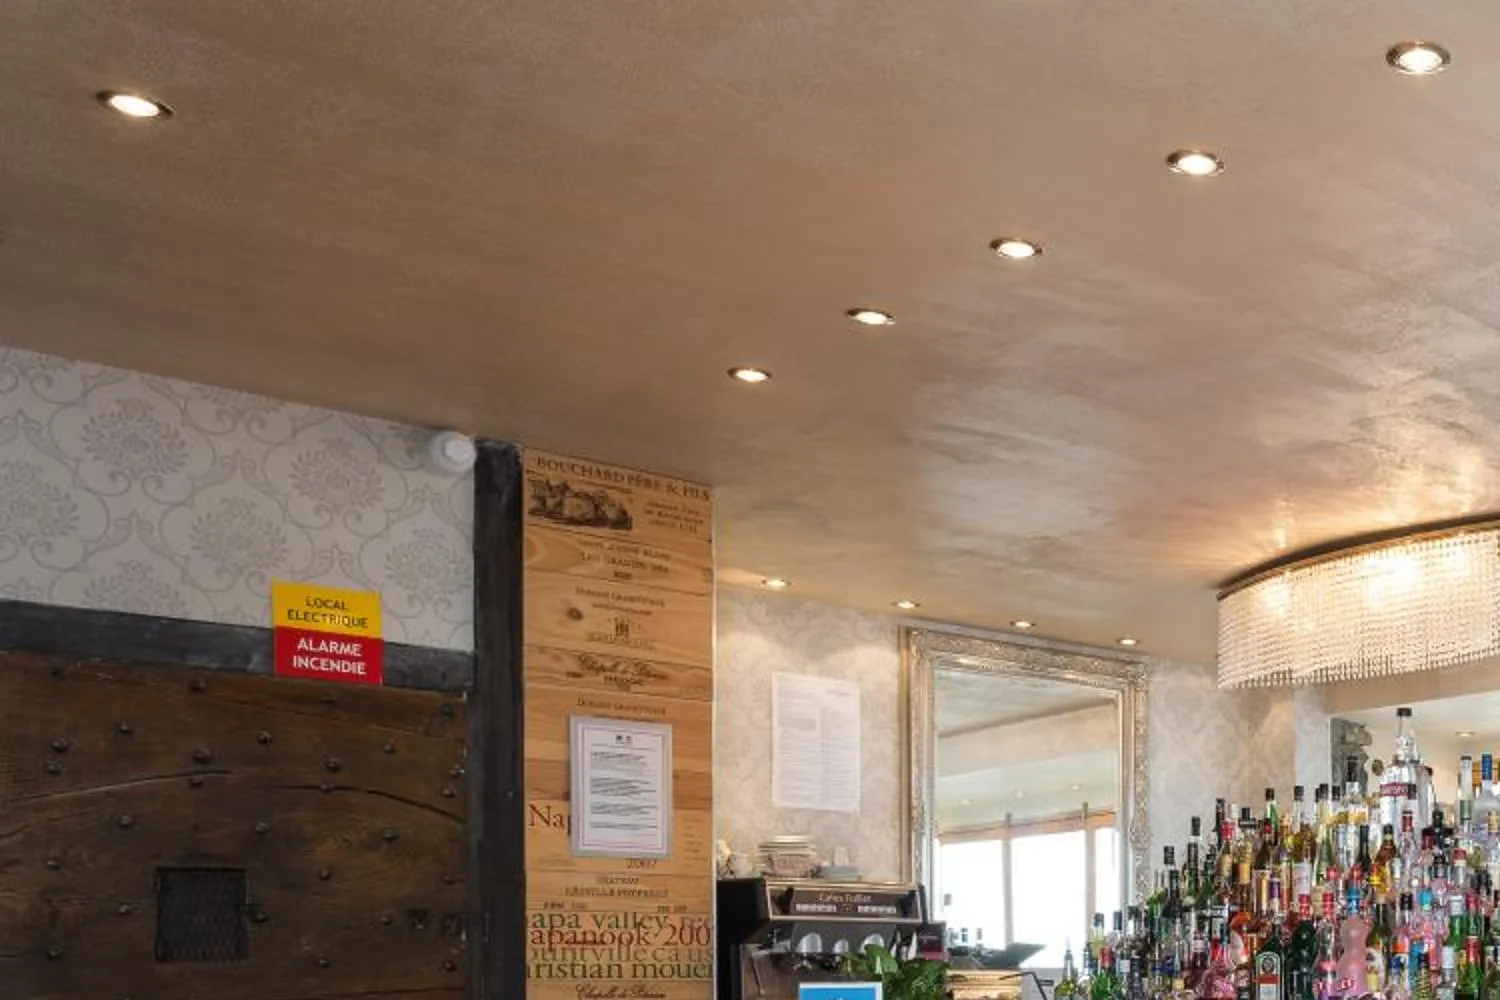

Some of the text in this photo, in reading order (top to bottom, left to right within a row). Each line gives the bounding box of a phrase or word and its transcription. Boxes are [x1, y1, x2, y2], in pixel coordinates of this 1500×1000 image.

[537, 455, 624, 484] BOUCHARD
[305, 595, 349, 611] LOCAL
[287, 608, 369, 629] ELECTRIQUE
[297, 637, 363, 657] ALARME
[292, 655, 367, 676] INCENDIE
